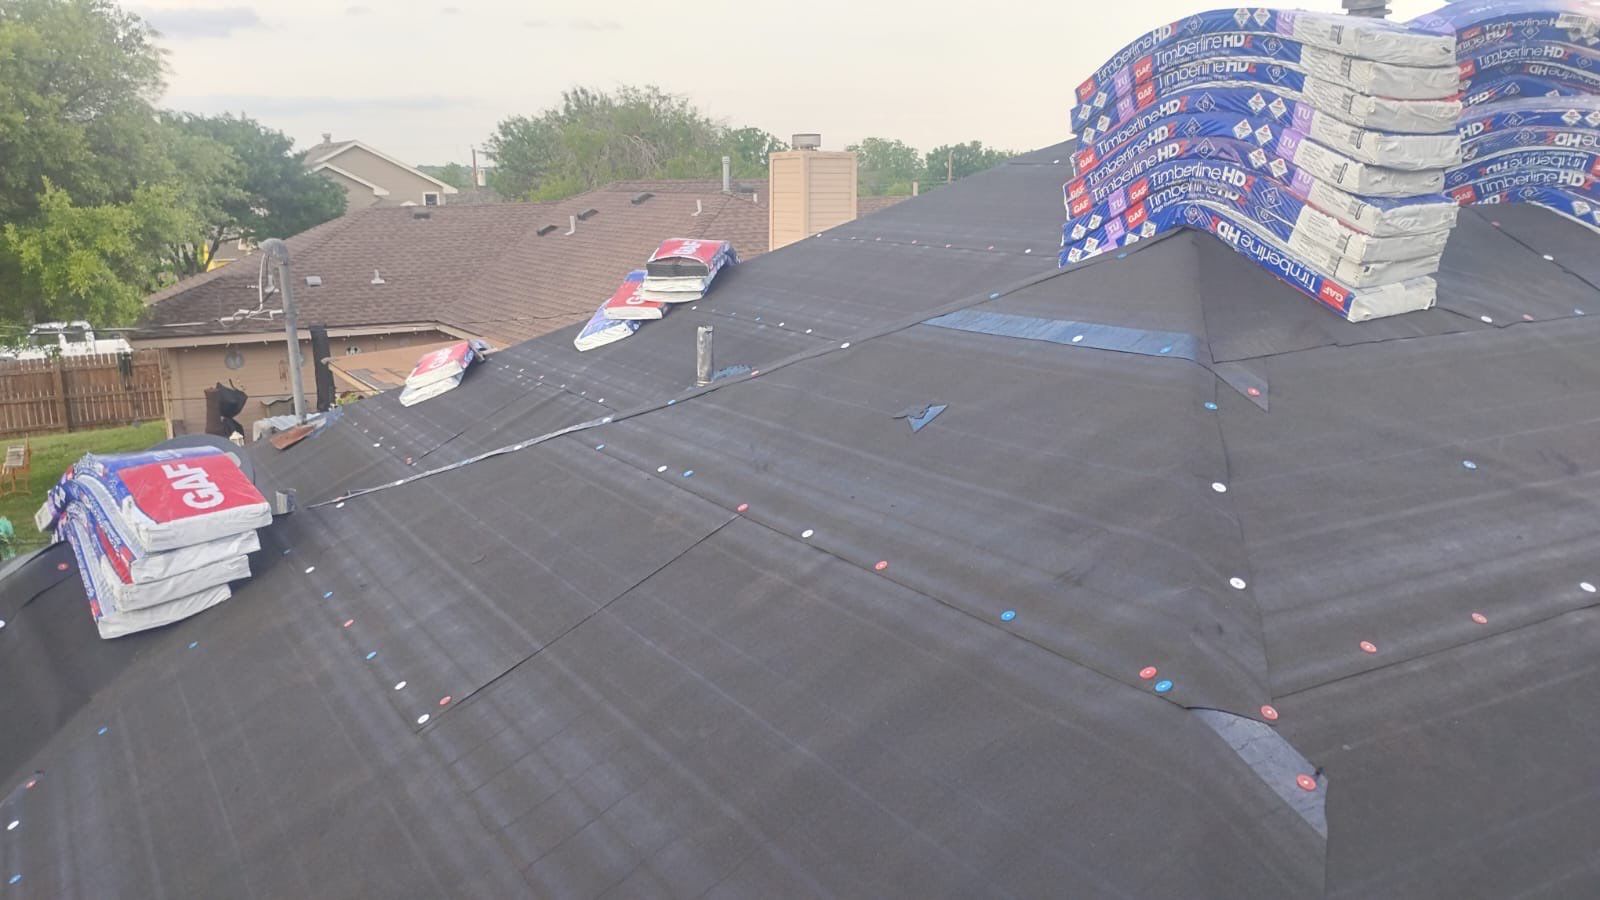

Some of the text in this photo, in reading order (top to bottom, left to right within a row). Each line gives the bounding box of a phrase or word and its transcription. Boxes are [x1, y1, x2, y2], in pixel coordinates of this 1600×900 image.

[1131, 186, 1148, 200] GAF
[1128, 208, 1144, 222] GAF
[1322, 287, 1344, 302] GAF
[161, 463, 225, 509] GAF
